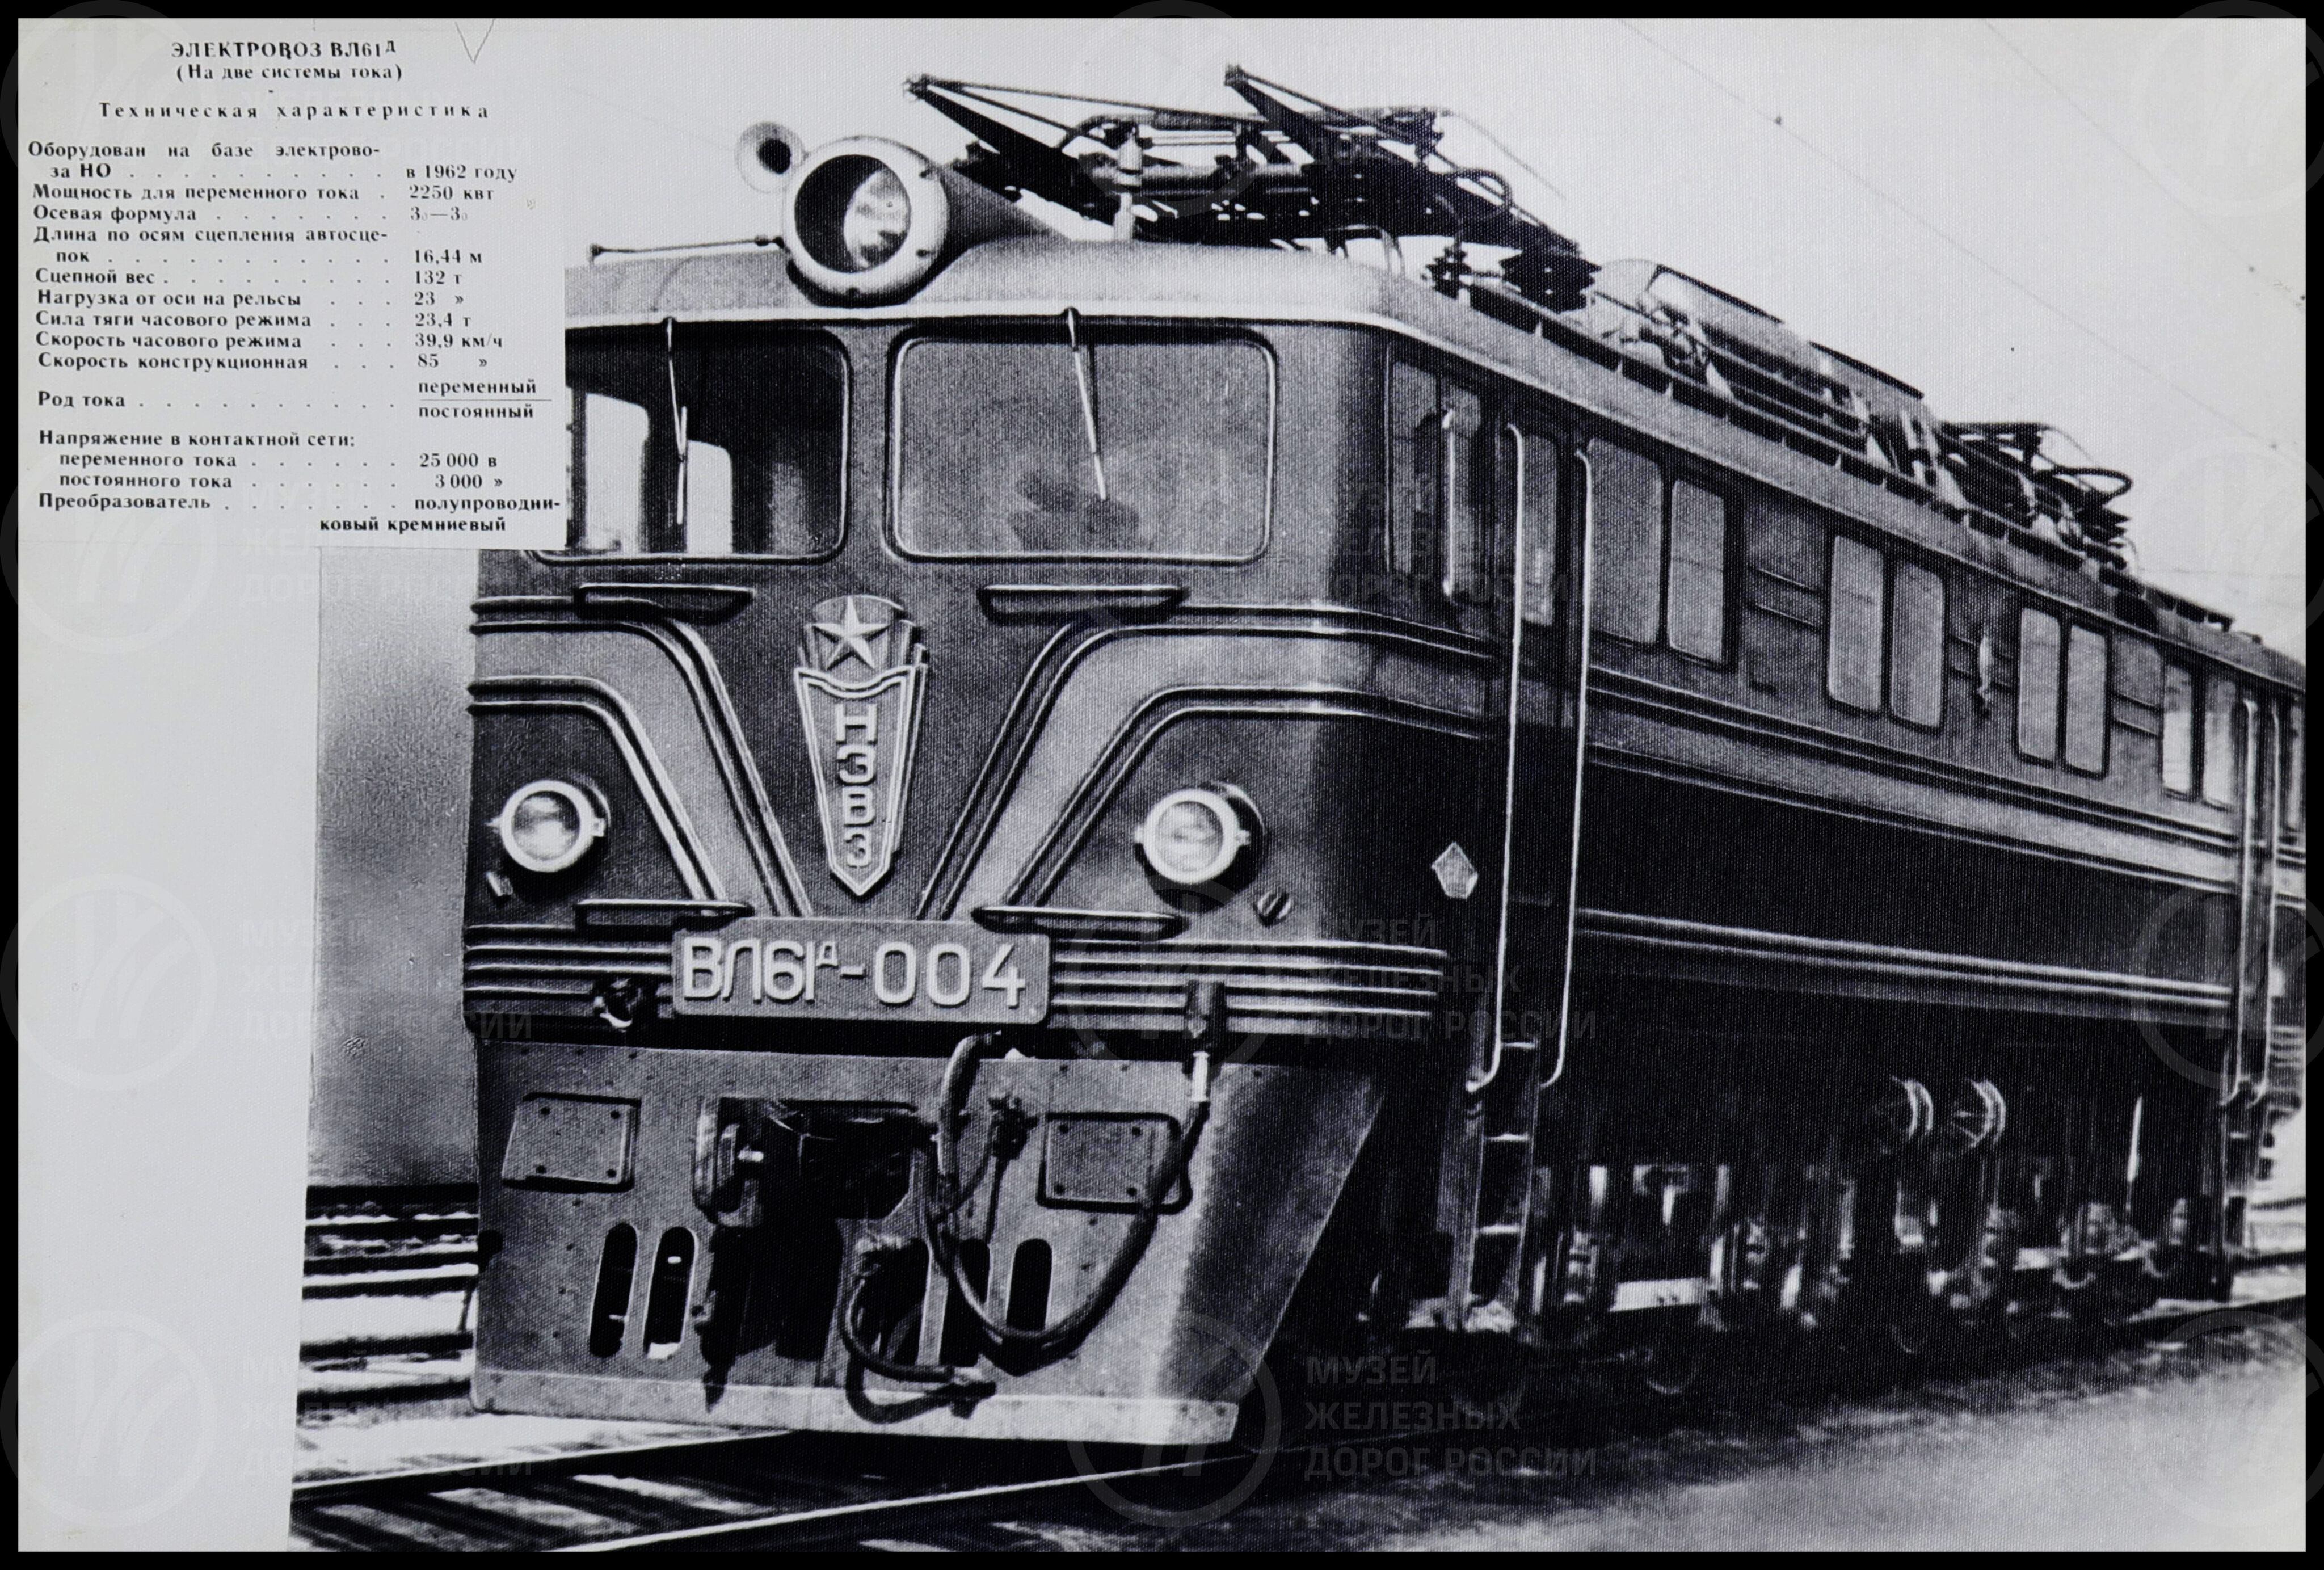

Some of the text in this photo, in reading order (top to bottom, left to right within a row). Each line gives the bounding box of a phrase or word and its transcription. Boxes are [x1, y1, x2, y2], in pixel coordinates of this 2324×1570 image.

[171, 41, 322, 60] ЭЛЕКТРОВОЗ
[176, 64, 402, 83] (На две системы тока)
[99, 102, 488, 121] Техническая характеристика
[28, 141, 380, 161] Оборудован на базе электрово-
[50, 167, 70, 179] за
[406, 168, 416, 179] в
[425, 164, 466, 179] 1962
[474, 167, 517, 184] году
[32, 183, 494, 203] Мощность для переменного тока 2250 квт
[33, 204, 102, 221] Осевая
[110, 206, 197, 225] формула
[33, 226, 388, 244] Длина по осям сцепления автосце-
[56, 249, 482, 265] пок 16,44 м
[35, 267, 462, 285] Сцепной вес 132 т
[37, 289, 129, 309] Нагрузка
[136, 294, 156, 305] от
[163, 294, 195, 306] оси
[203, 294, 225, 306] на
[233, 294, 301, 309] рельсы
[414, 291, 436, 306] 23
[35, 310, 471, 330] Сила тяги часового режима 23,4 т
[35, 331, 503, 351] Скорость часового режима 39,9 км/ч
[37, 351, 128, 372] Скорость
[138, 357, 308, 373] конструкционная
[417, 353, 439, 368] 85
[418, 378, 537, 397] переменный
[37, 390, 125, 409] Род тока
[418, 403, 533, 419] постоянный
[39, 429, 355, 449] Напряжение в контактной сети:
[60, 454, 184, 469] переменного
[193, 456, 237, 468] тока
[487, 457, 498, 468] в
[59, 475, 181, 488] постоянного
[189, 477, 233, 489] тока
[39, 492, 559, 515] Преобразователь полупроводни-
[320, 516, 506, 535] ковый кремниевый
[834, 702, 878, 868] НЭВЗ
